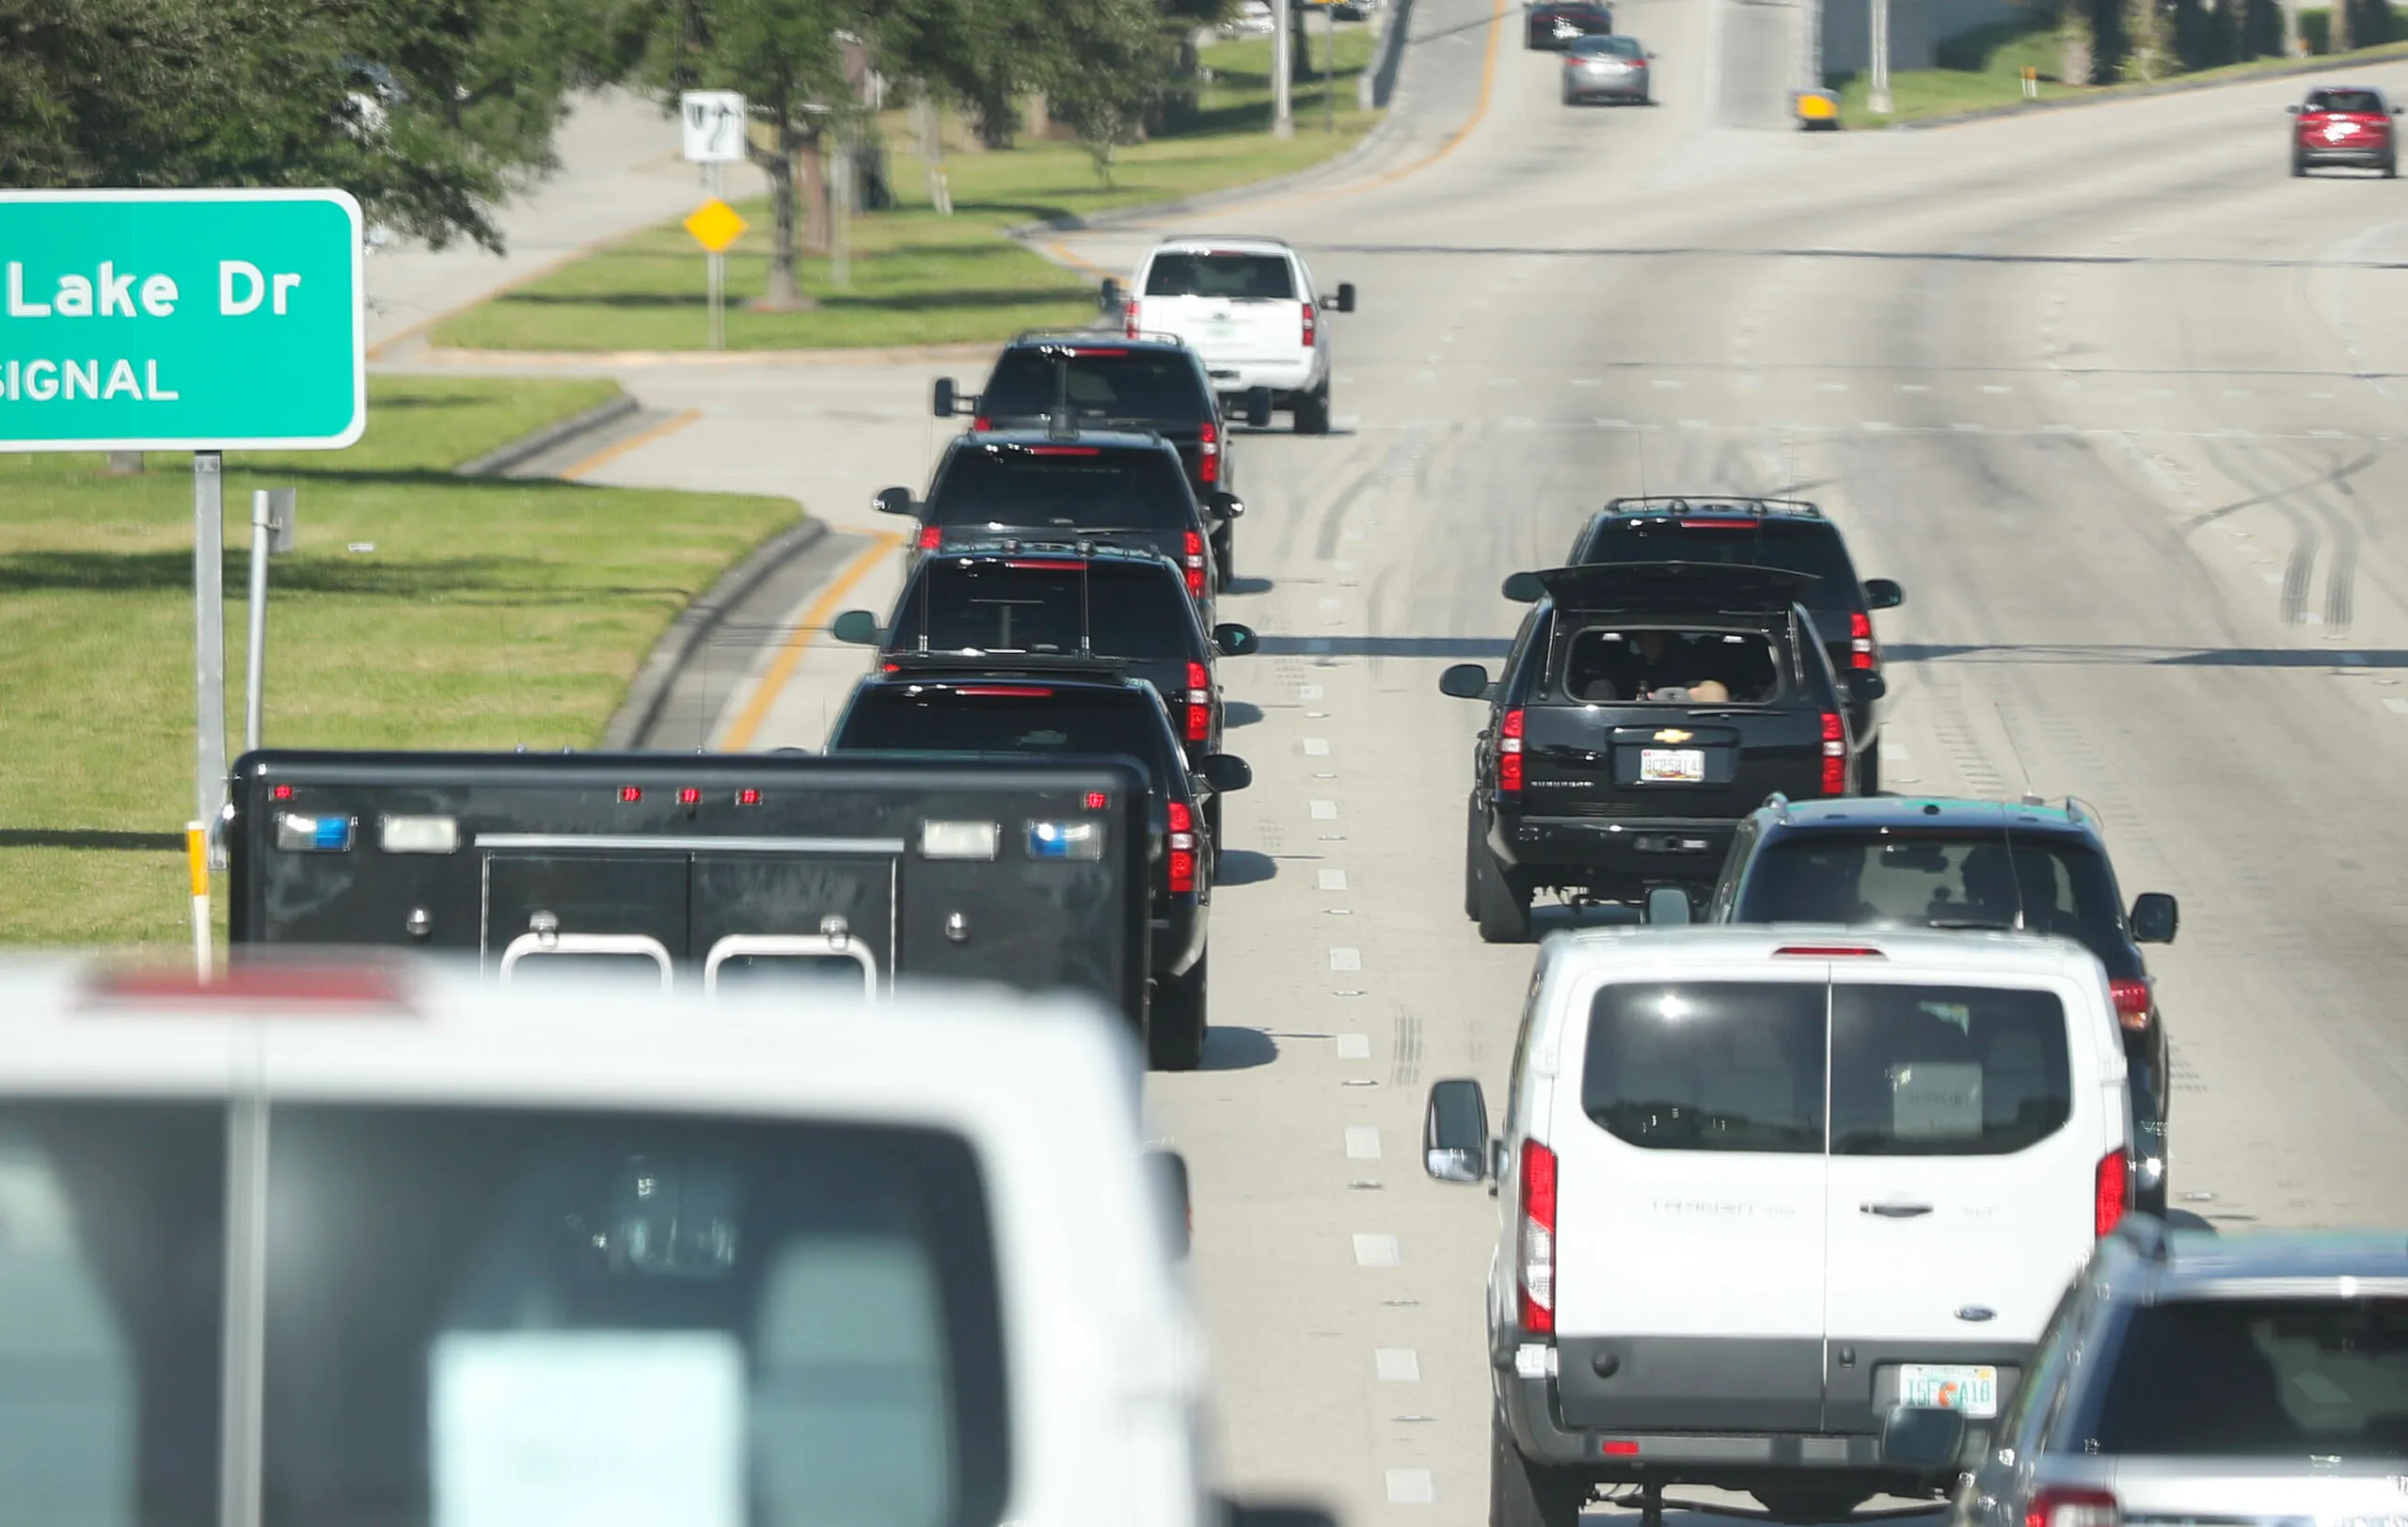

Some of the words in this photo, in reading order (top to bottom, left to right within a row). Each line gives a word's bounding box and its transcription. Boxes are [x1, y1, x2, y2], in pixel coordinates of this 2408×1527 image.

[6, 260, 180, 317] Lake
[218, 260, 302, 316] Dr
[0, 358, 180, 401] IGNAL
